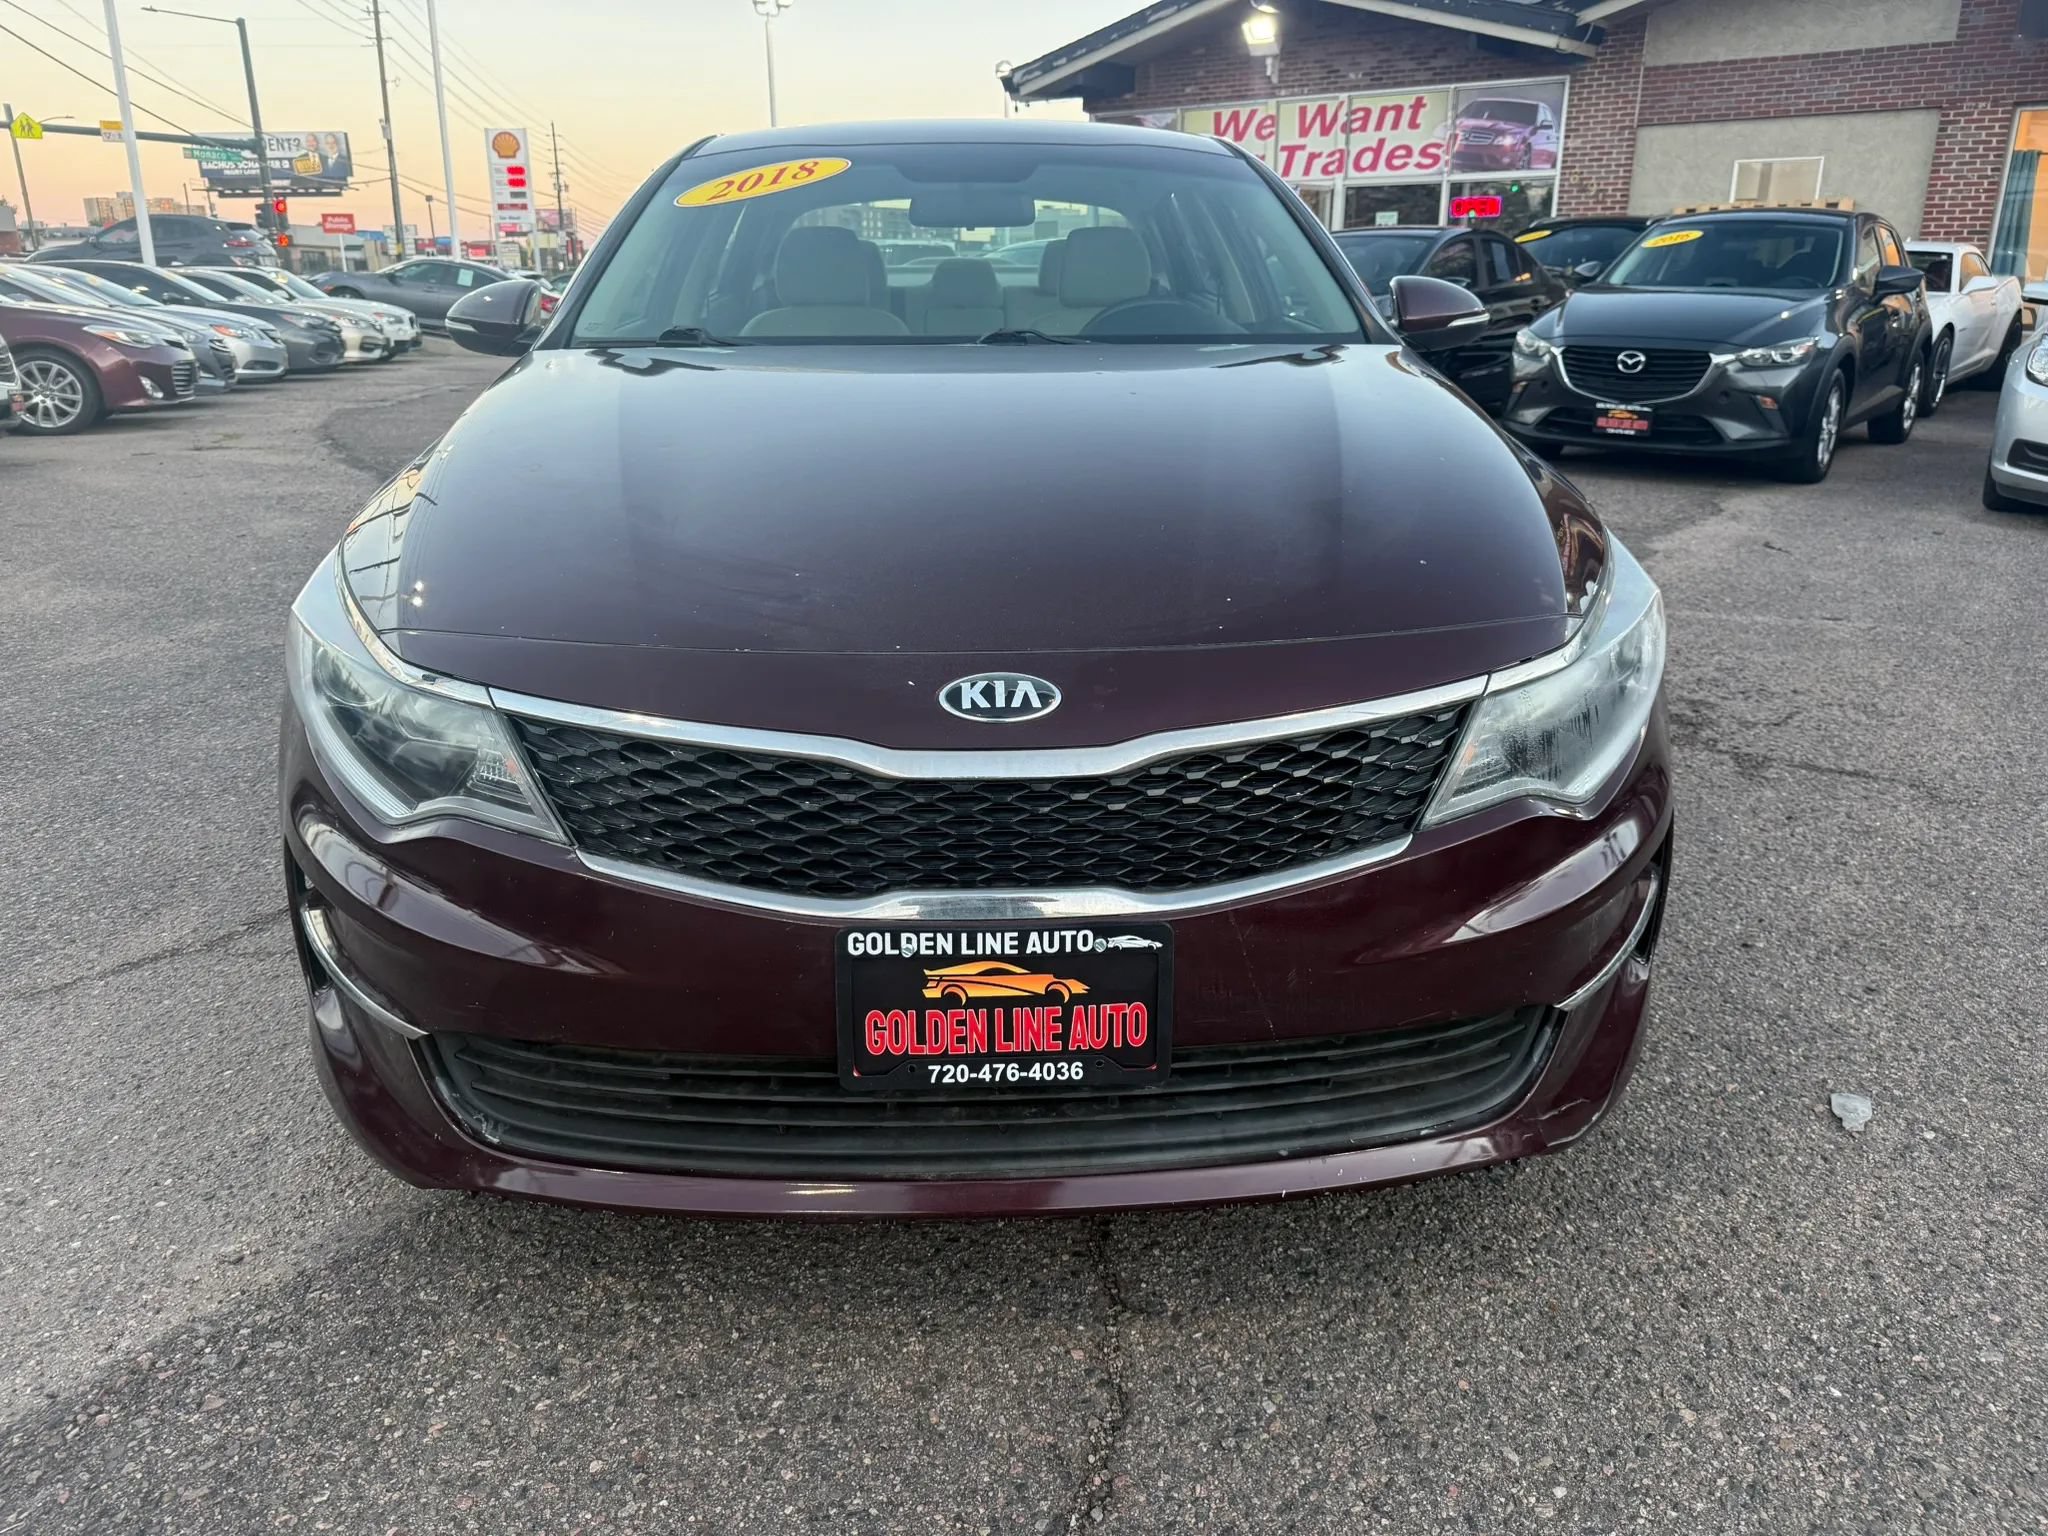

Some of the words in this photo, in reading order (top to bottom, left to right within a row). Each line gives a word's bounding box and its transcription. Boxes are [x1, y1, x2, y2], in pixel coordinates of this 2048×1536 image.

[1214, 108, 1277, 142] We
[1297, 96, 1428, 138] Want
[192, 149, 227, 160] Monaco
[706, 160, 820, 201] 2018
[960, 680, 1042, 709] KIA
[847, 932, 954, 957] GOLDEN
[960, 931, 1018, 955] LINE
[1026, 930, 1094, 954] AUTO
[865, 1008, 988, 1056] GOLDEN
[994, 1006, 1062, 1053] LINE
[1068, 1002, 1148, 1050] AUTO
[927, 1061, 1084, 1083] 720-476-4036
